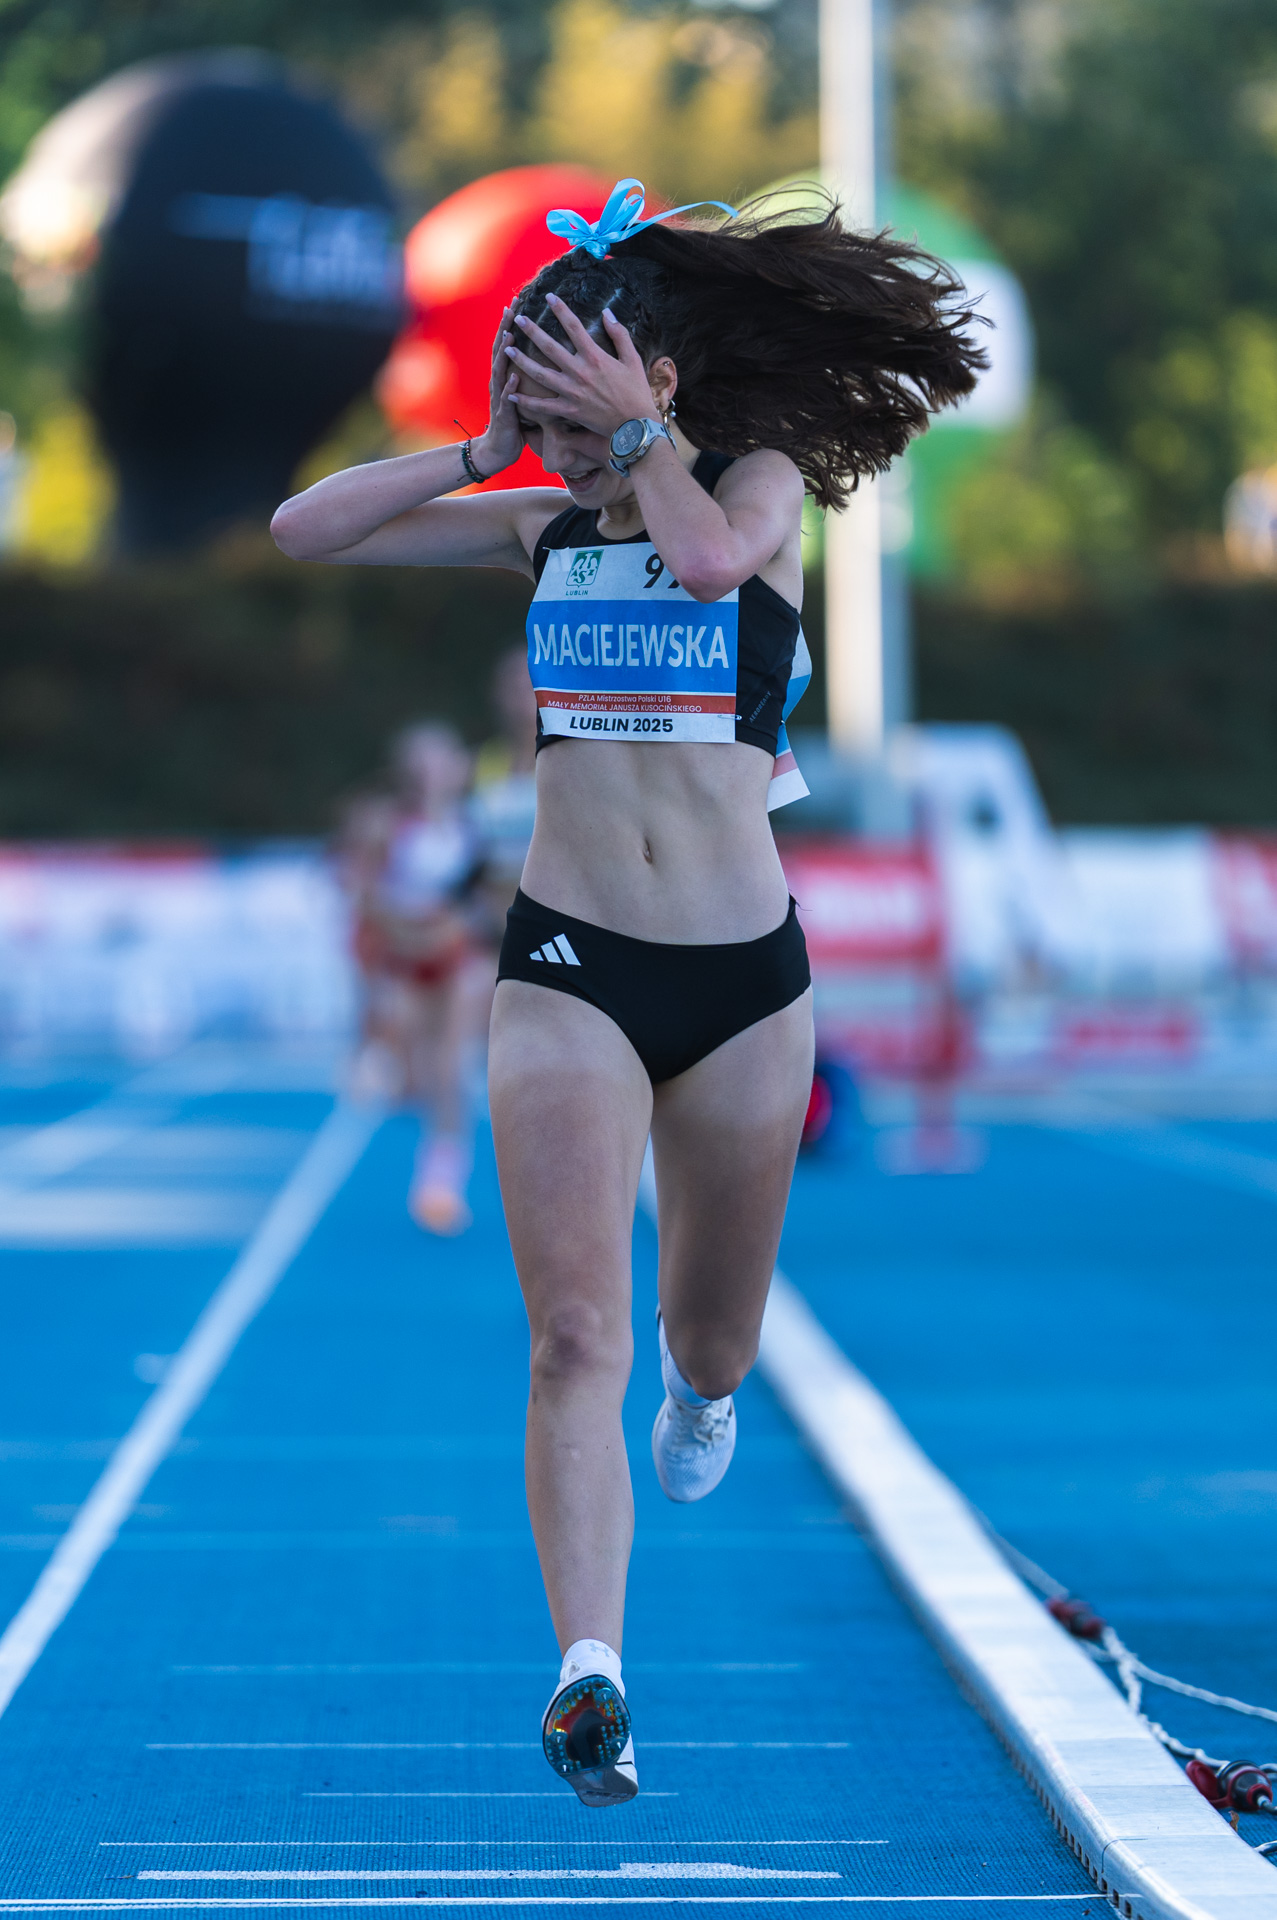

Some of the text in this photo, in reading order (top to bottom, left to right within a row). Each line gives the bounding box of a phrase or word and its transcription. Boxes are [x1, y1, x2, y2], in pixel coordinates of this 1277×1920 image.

[643, 552, 680, 588] 9
[533, 623, 730, 669] MACIEJEWSKA
[547, 700, 702, 713] MAŁY MEMORIAŁ JANUSZA KUSOCIŃSKIEGO
[578, 694, 672, 703] PZLA Mistrzostwa Polski U16
[749, 690, 772, 724] AEROREADY
[569, 716, 674, 733] LUBLIN 2025
